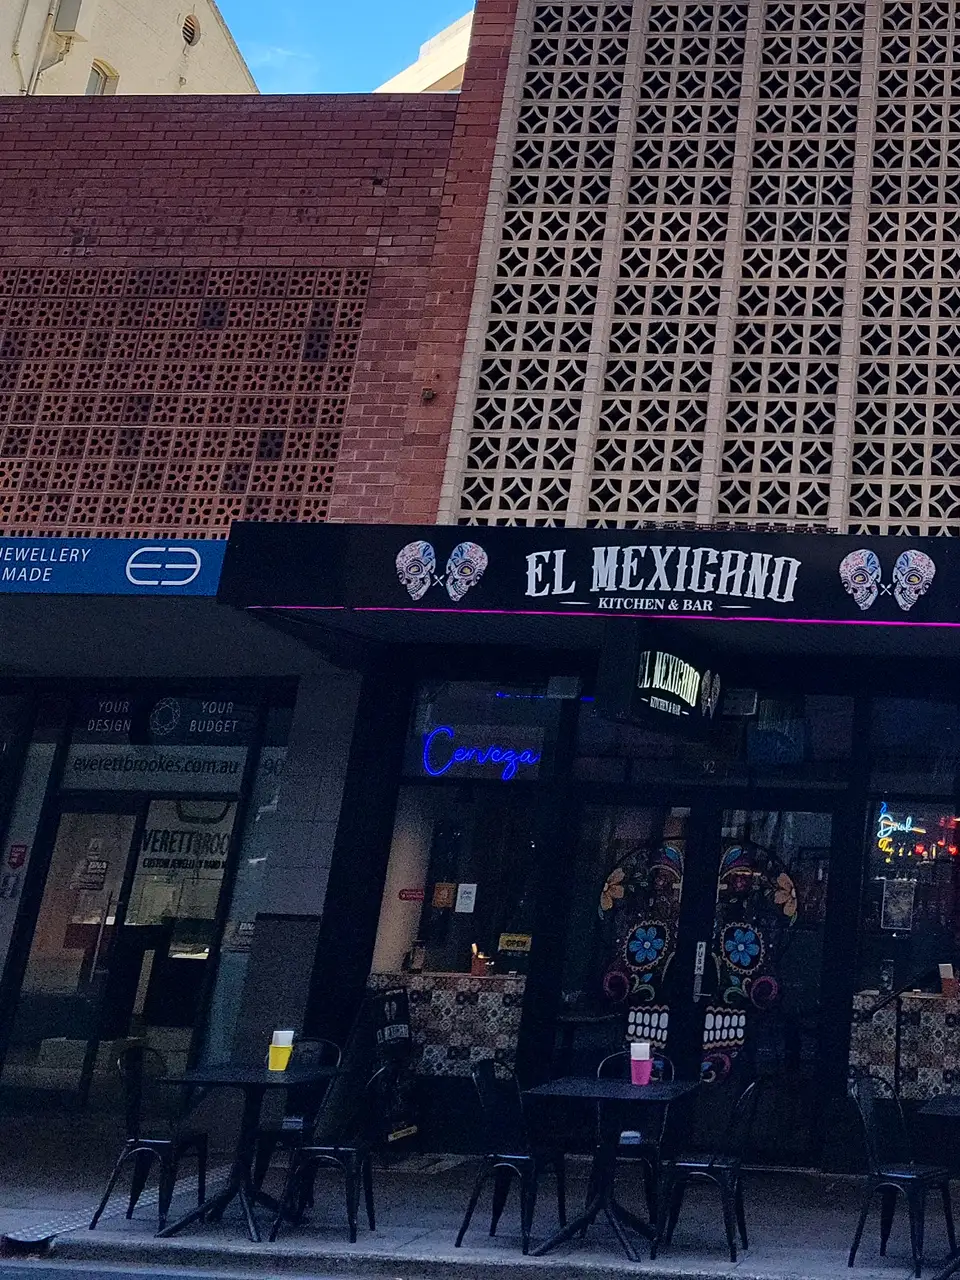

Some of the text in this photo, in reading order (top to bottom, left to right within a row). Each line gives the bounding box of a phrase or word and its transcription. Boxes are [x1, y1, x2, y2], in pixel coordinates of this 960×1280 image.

[1, 567, 53, 582] MADE
[524, 545, 803, 604] EL MEXICANO
[598, 597, 714, 613] KITCHEN & BAR
[99, 700, 234, 714] YOUR YOUR
[87, 719, 239, 733] DESIGN BUDGET
